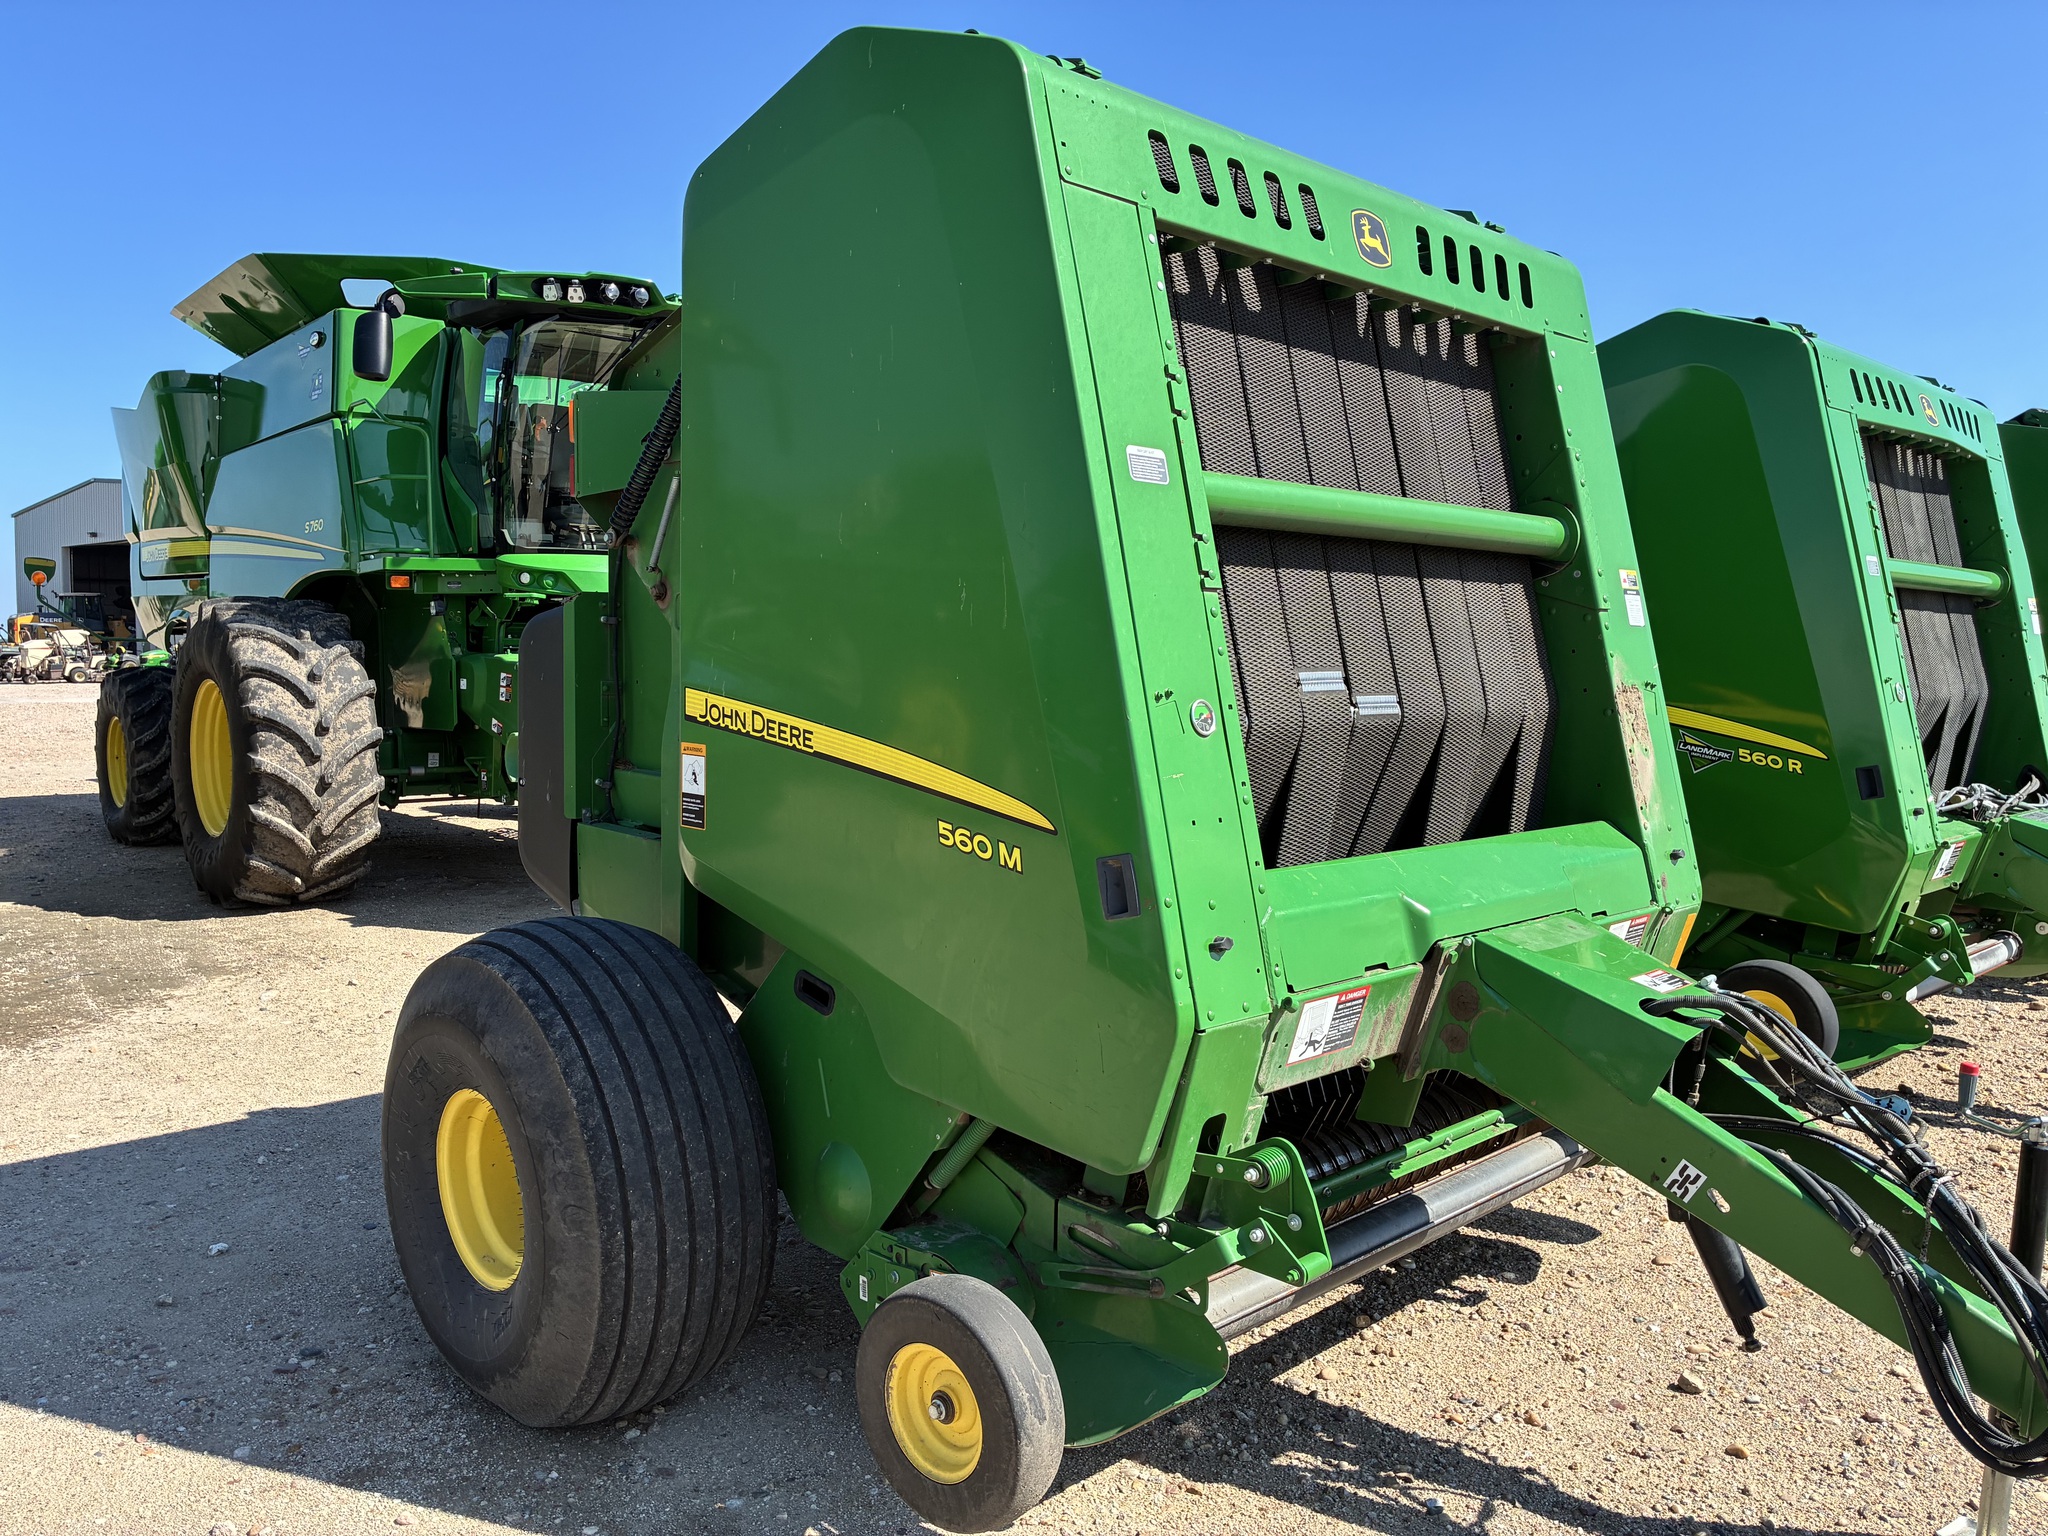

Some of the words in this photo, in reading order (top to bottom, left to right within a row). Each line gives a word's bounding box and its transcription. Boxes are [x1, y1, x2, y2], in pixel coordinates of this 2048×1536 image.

[304, 518, 324, 534] S760
[698, 697, 747, 731] JOHN
[751, 709, 814, 750] DEERE
[1679, 742, 1731, 760] LANDMARK
[1691, 751, 1719, 761] IMPLEMENT
[1738, 747, 1783, 770] 560
[1788, 758, 1803, 774] R
[938, 819, 993, 861] 560
[998, 840, 1022, 873] M
[1346, 989, 1367, 1000] DANGER
